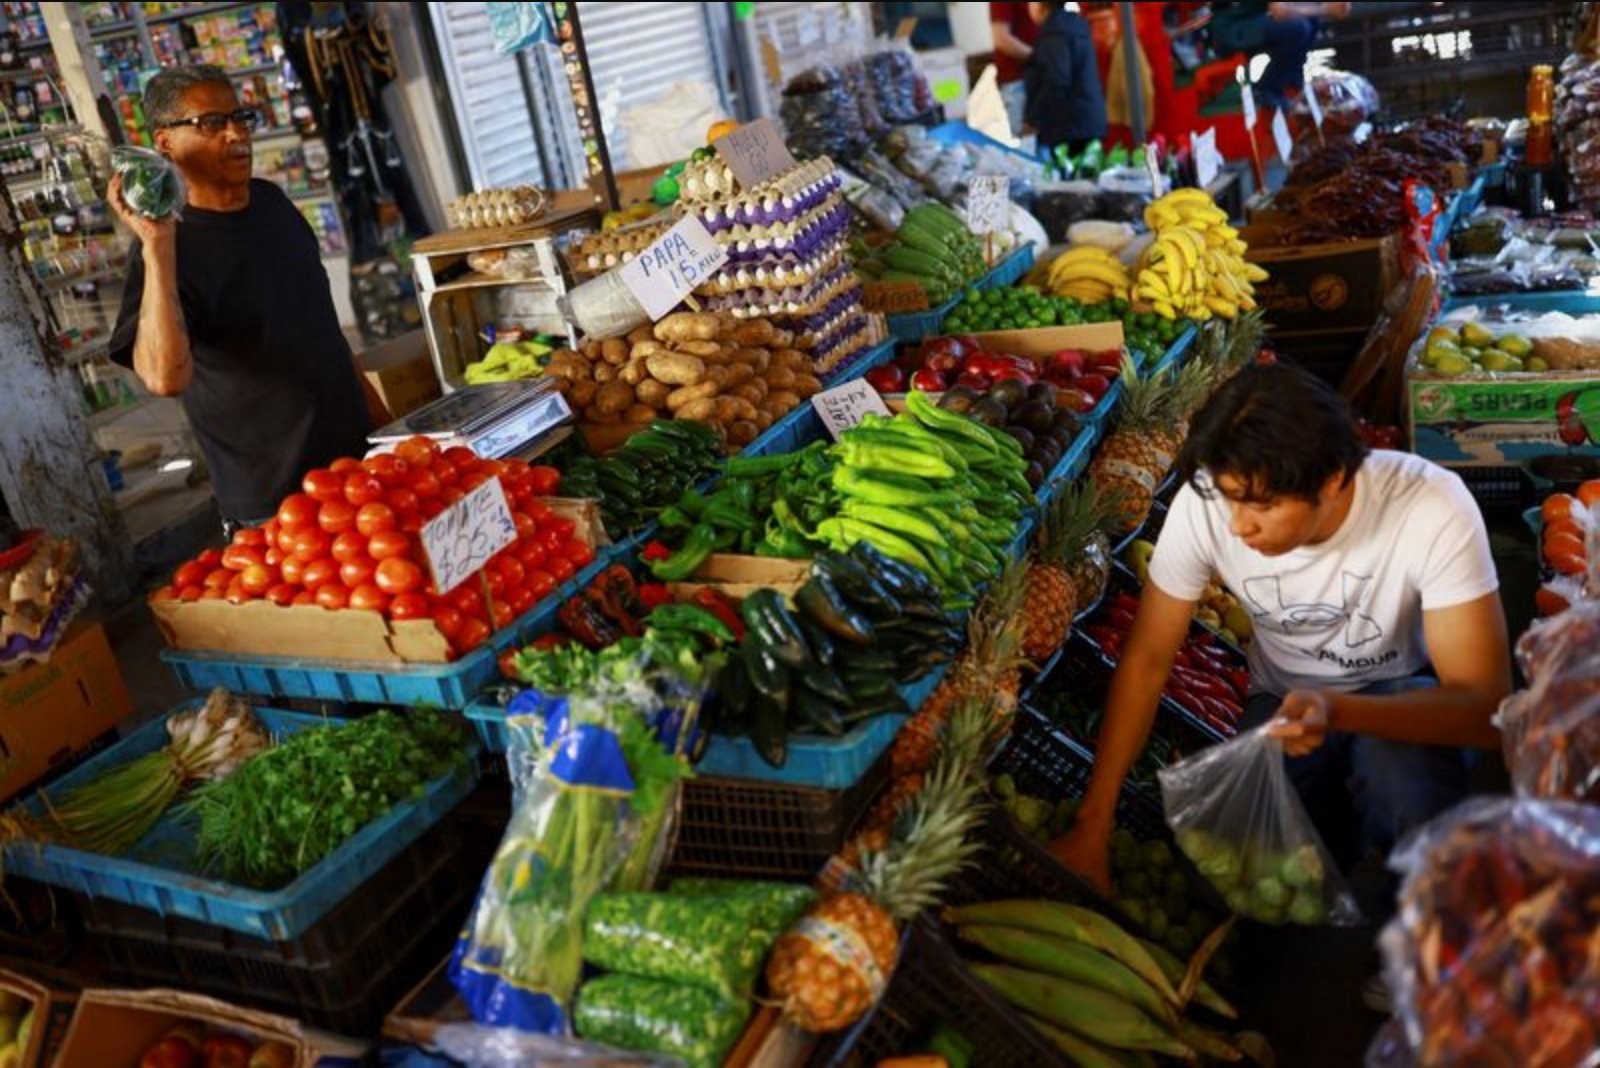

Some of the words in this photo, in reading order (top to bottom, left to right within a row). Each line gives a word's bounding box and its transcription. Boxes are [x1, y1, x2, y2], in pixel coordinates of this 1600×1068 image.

[640, 232, 691, 276] PAPA
[669, 258, 697, 289] 15
[1472, 393, 1548, 411] PEARS
[425, 483, 496, 549] TOMATE
